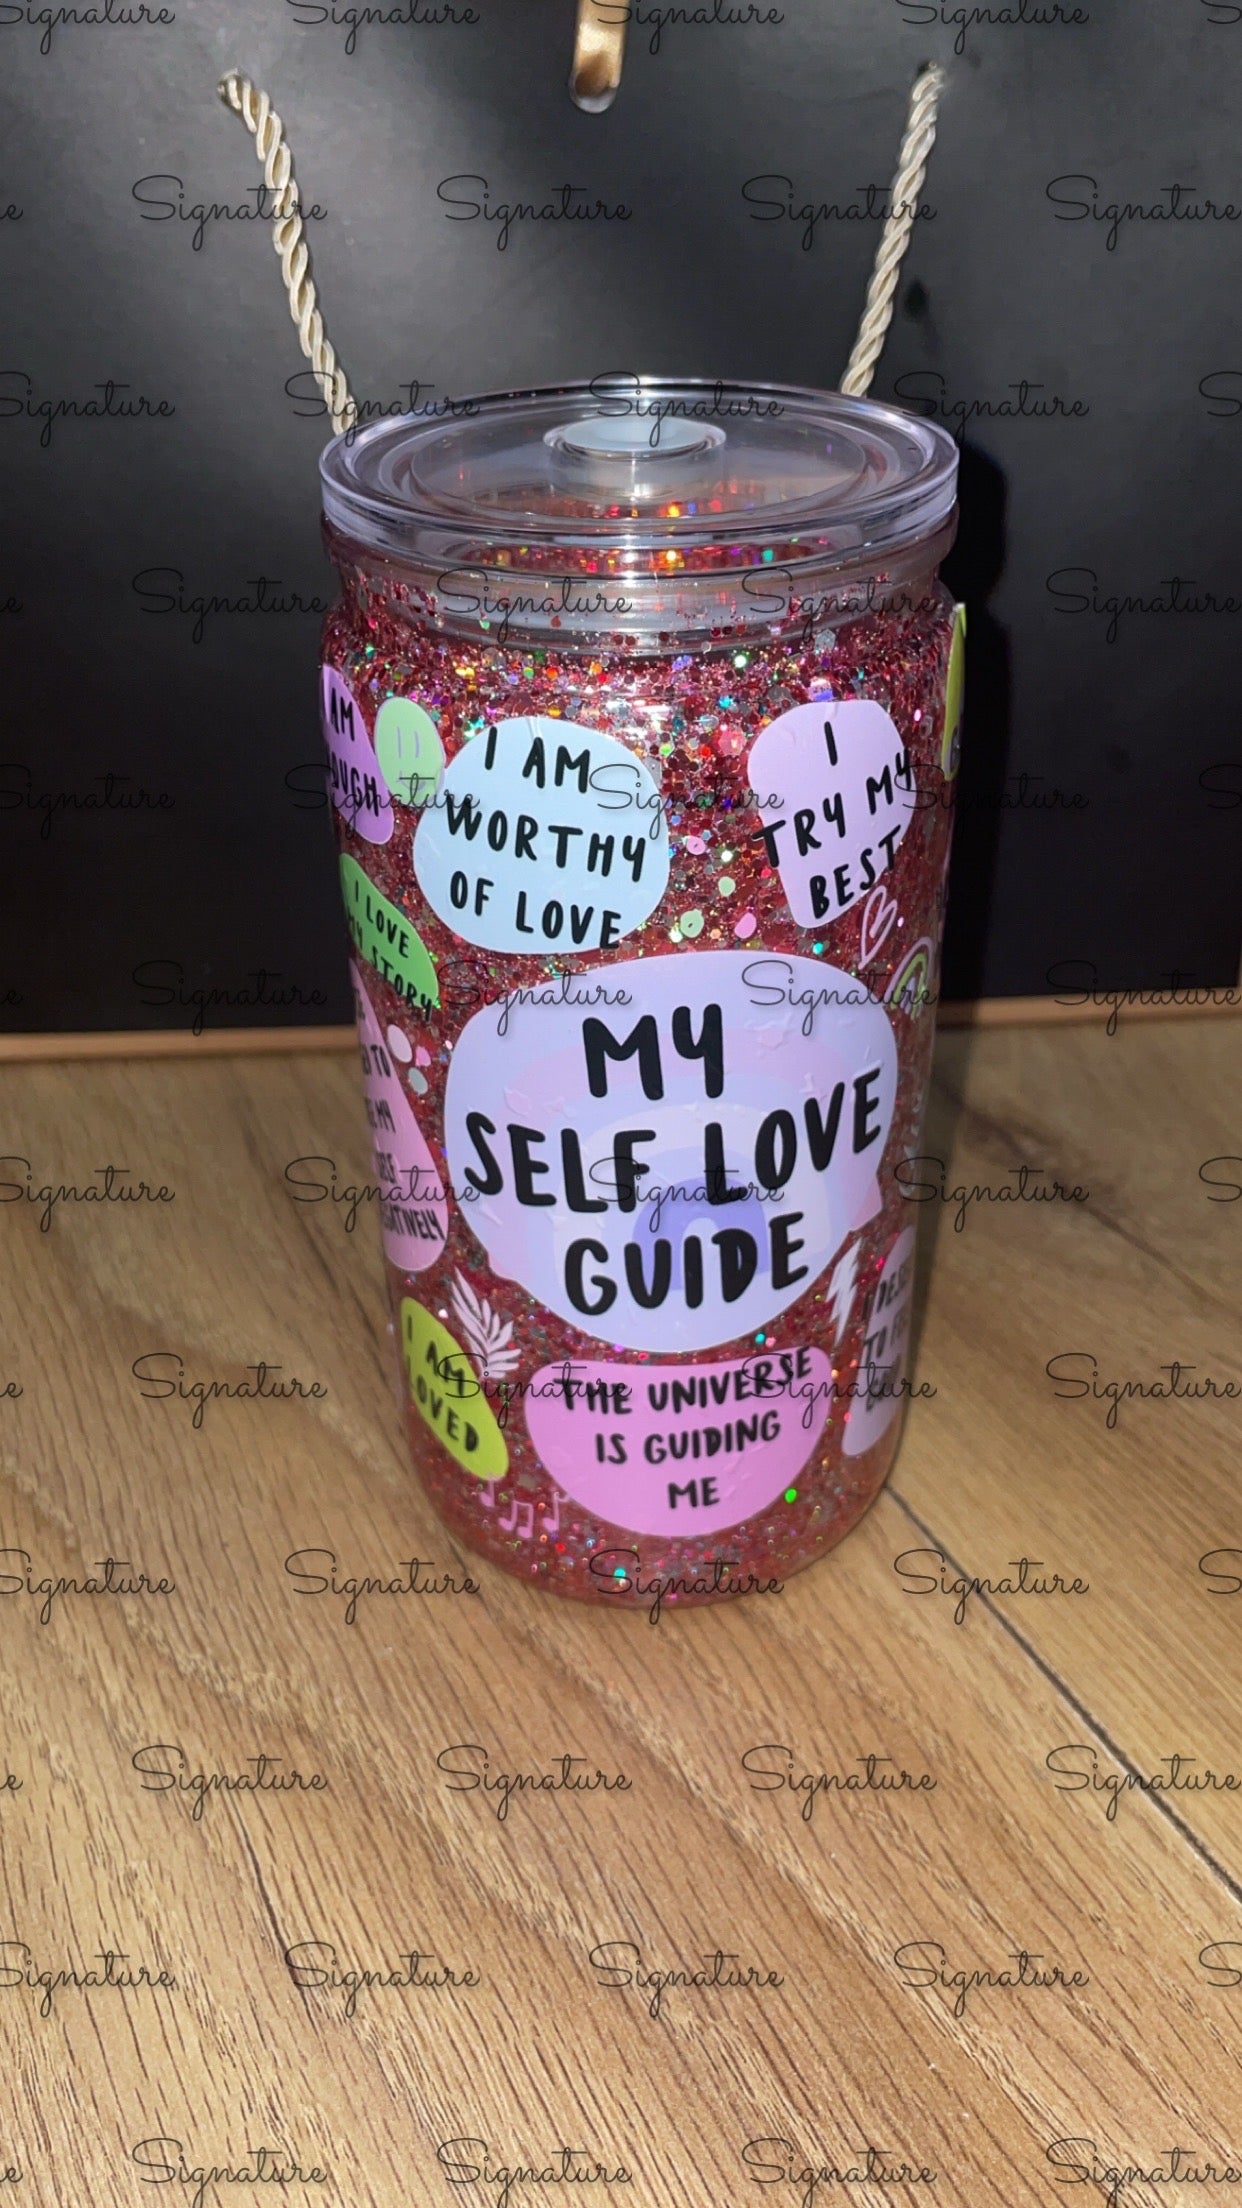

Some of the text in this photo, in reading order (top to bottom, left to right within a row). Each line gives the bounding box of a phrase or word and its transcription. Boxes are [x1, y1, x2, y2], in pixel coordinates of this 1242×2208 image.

[330, 688, 355, 741] AM
[823, 720, 839, 767] I
[484, 726, 591, 793] I AM
[446, 795, 647, 882] WORTHY
[751, 750, 913, 868] TRY MY
[450, 870, 621, 950] OF LOVE
[809, 823, 902, 919] BEST
[353, 879, 410, 958] I LOVE
[371, 947, 433, 1022] STORY
[582, 1003, 724, 1100] MY
[464, 1068, 881, 1213] SELF LOVE
[564, 1212, 809, 1316] GUIDE
[407, 1314, 465, 1397] I AM
[553, 1376, 632, 1416] THE
[648, 1345, 812, 1415] UNIVERSE
[596, 1409, 781, 1466] IS GUIDING
[667, 1476, 720, 1510] ME
